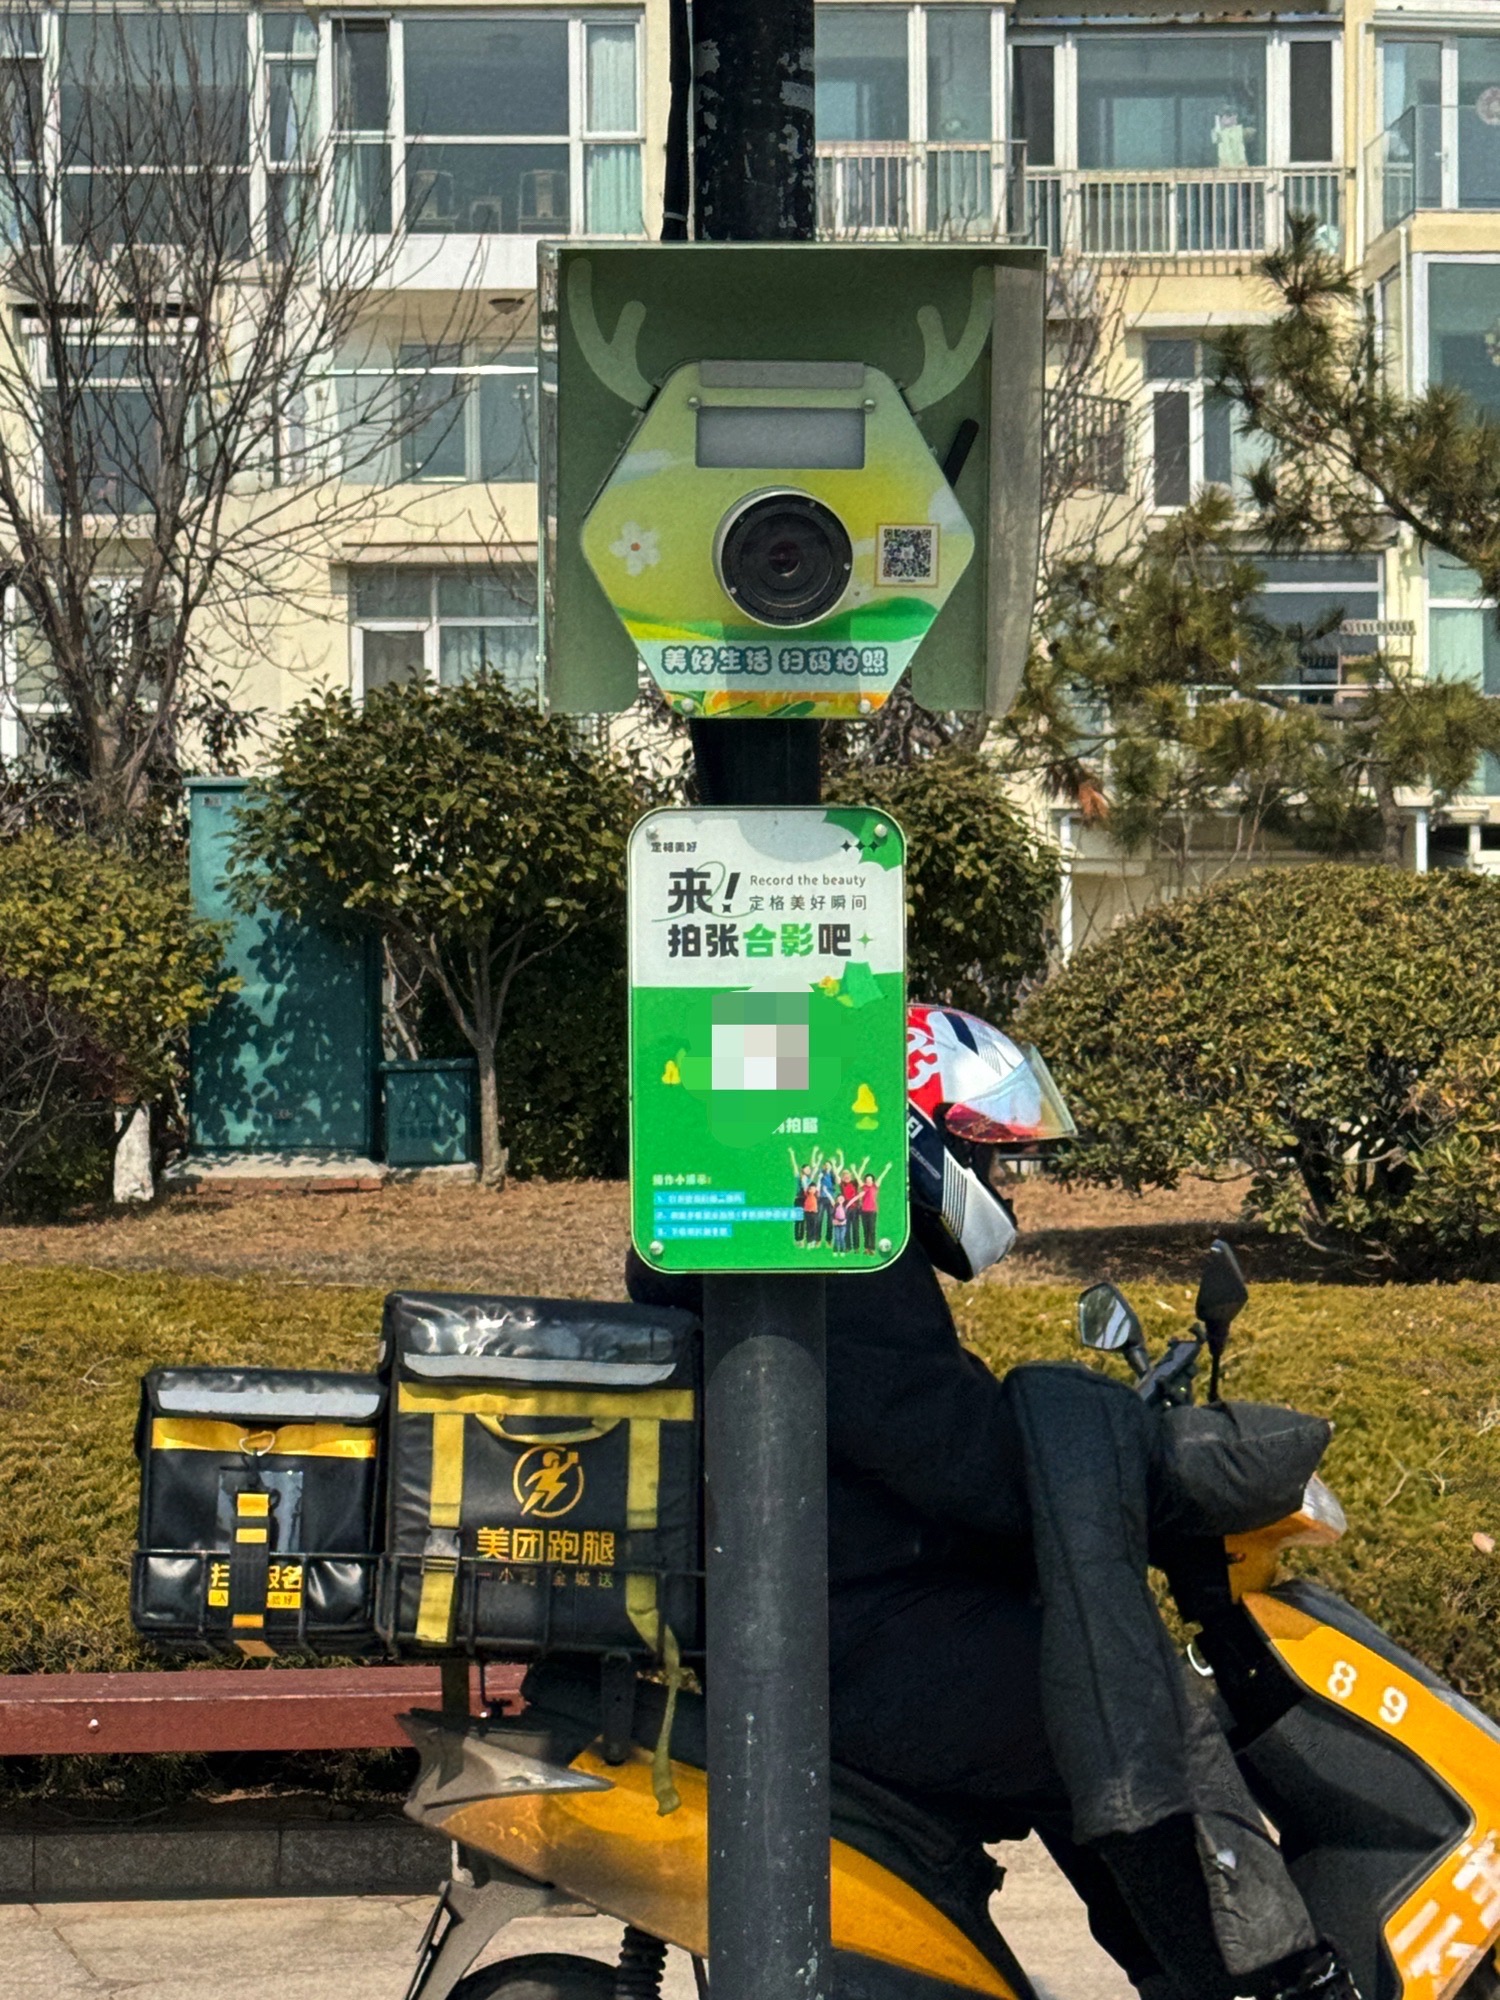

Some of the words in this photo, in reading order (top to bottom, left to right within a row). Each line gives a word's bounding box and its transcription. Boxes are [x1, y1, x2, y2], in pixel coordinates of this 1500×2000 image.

[663, 647, 770, 673] 美好生活
[780, 648, 888, 675] 扫码拍照
[750, 874, 794, 886] Record
[798, 874, 819, 886] the
[823, 874, 866, 888] beauty
[749, 895, 867, 911] 定格美好瞬间
[668, 923, 851, 957] 拍张合影吧
[476, 1527, 615, 1566] 美团跑腿
